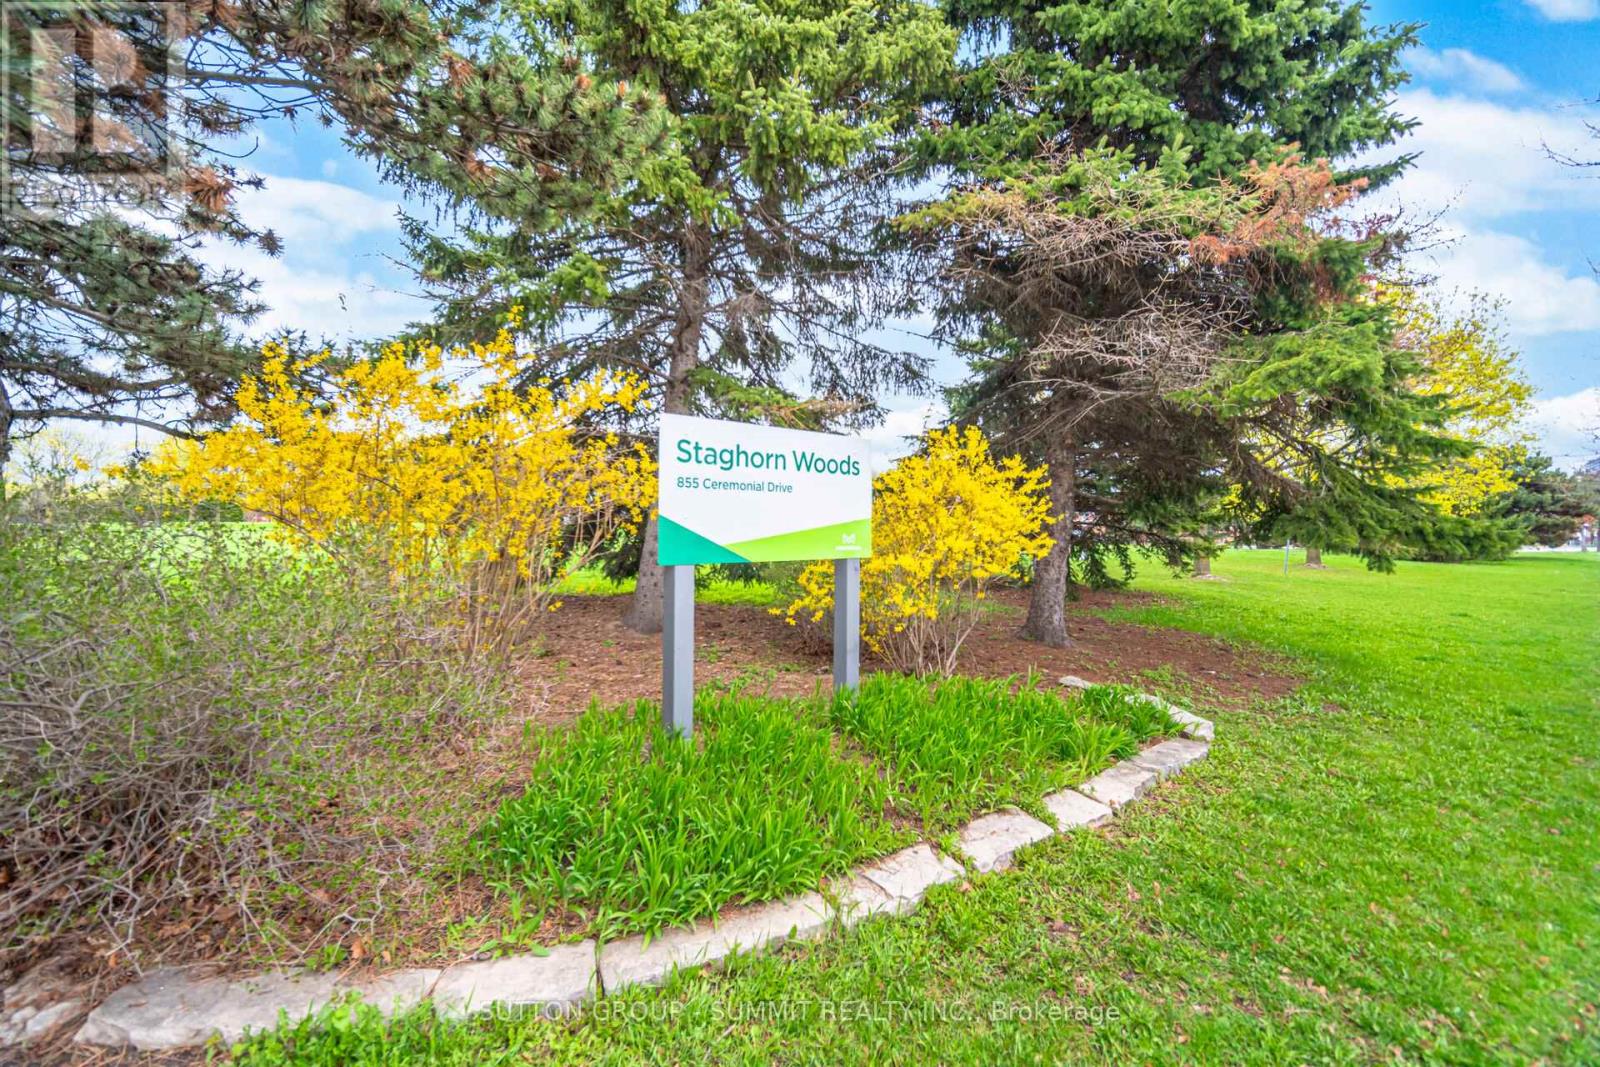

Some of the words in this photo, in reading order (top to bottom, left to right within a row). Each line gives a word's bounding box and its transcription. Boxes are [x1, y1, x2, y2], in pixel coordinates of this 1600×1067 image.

[676, 439, 787, 471] Staghorn
[792, 449, 861, 476] Woods
[676, 476, 700, 489] 855
[702, 478, 764, 492] Ceremonial
[767, 481, 794, 494] Drive
